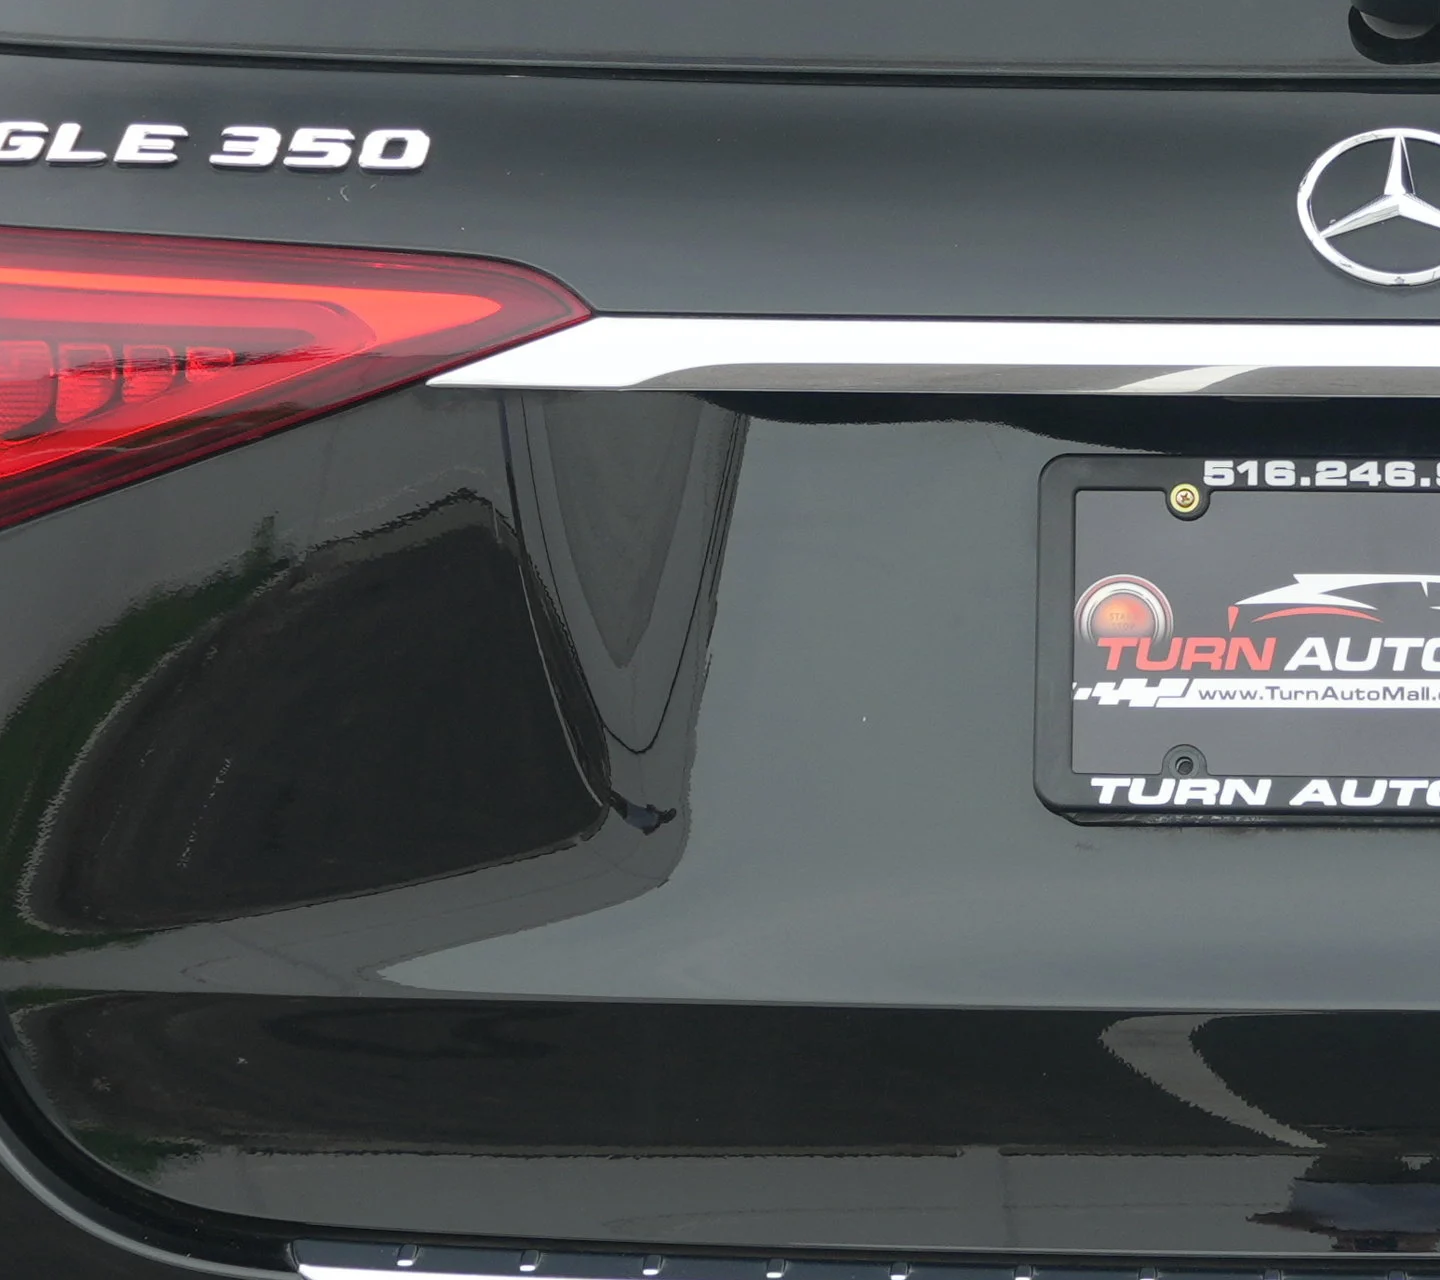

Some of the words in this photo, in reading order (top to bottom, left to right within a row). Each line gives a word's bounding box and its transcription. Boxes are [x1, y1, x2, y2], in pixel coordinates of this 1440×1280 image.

[208, 126, 431, 171] 350
[1097, 637, 1276, 671] TURN
[1090, 778, 1270, 806] TURN
